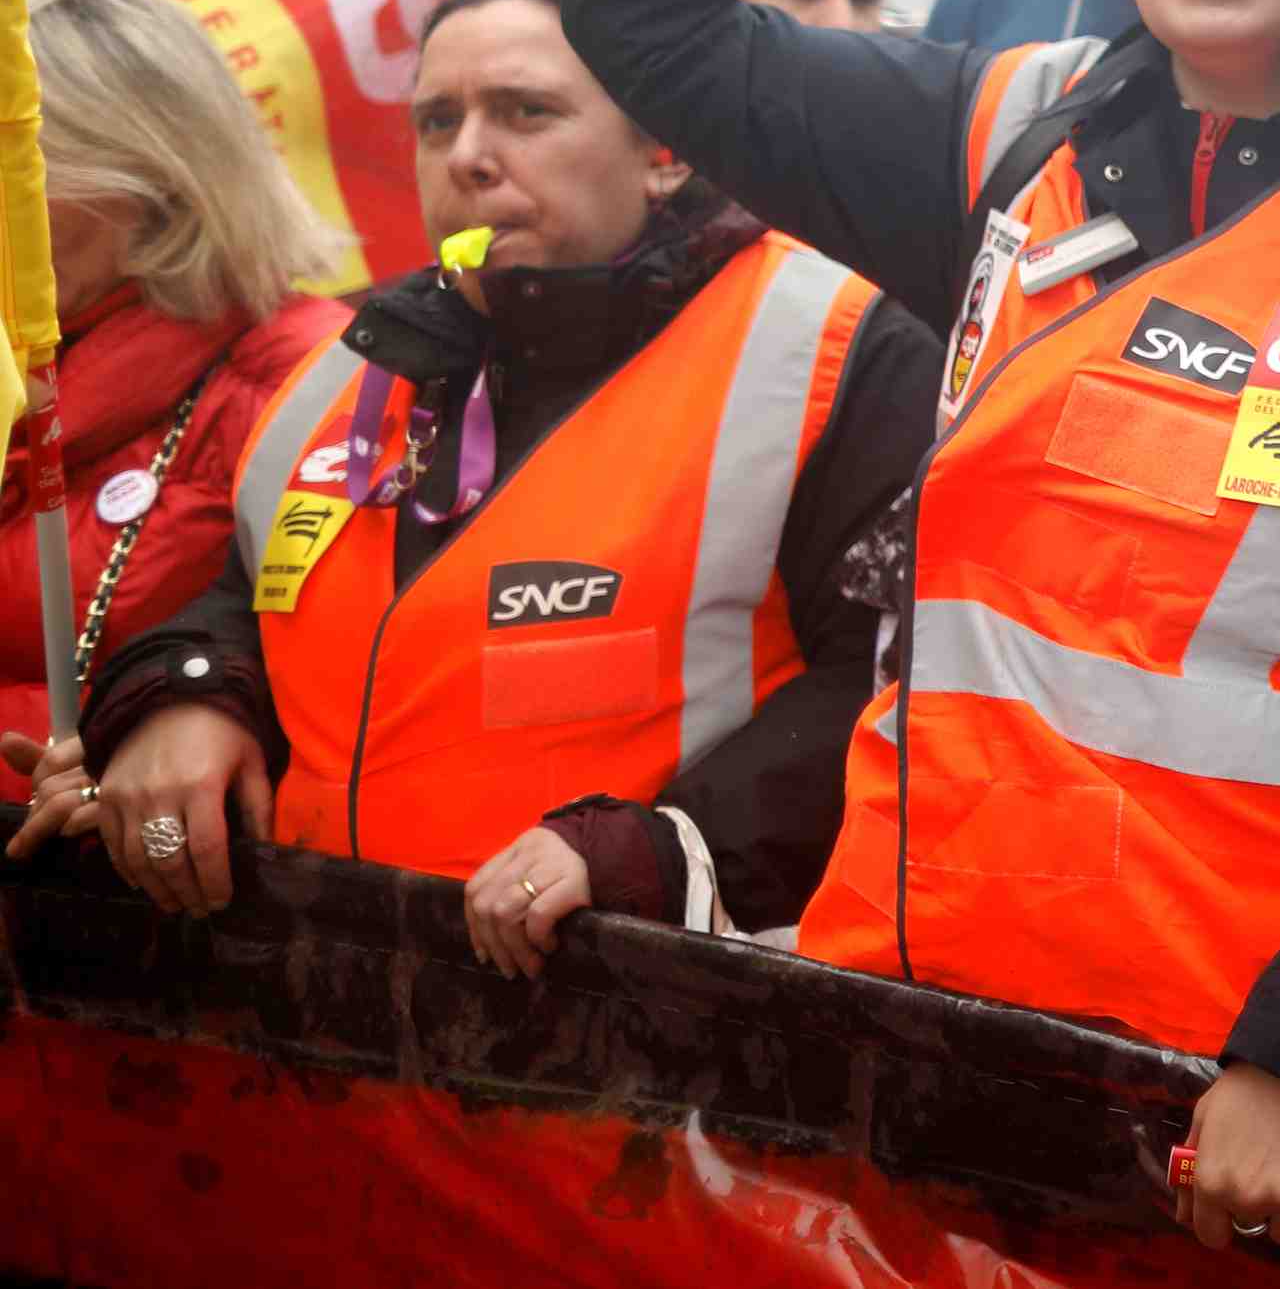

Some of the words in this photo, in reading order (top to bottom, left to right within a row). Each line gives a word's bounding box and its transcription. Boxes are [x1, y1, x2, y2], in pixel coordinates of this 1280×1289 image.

[1132, 327, 1256, 380] SNCF
[1254, 404, 1274, 415] DES
[493, 575, 615, 620] SNCF
